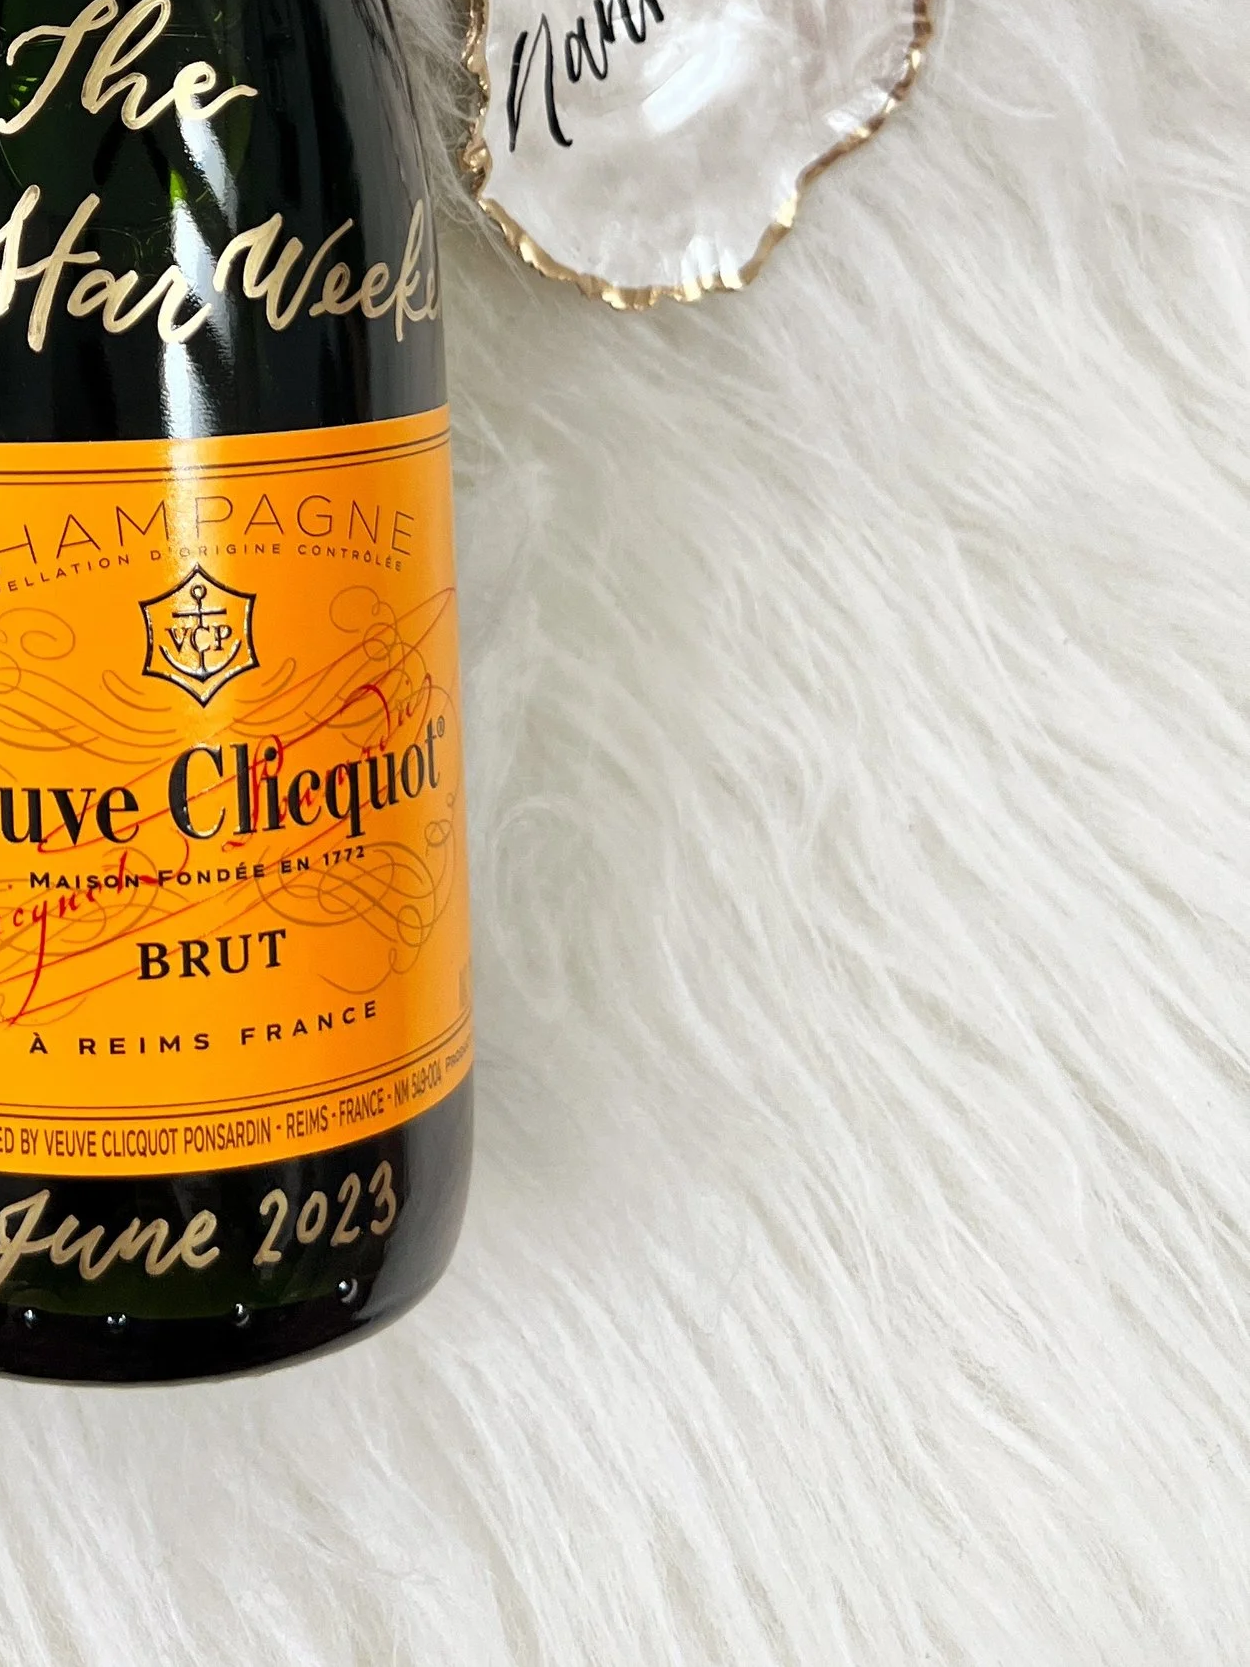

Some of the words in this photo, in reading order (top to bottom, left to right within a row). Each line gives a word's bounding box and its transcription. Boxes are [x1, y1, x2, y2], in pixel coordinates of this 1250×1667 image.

[150, 542, 282, 562] D'ORIGINE
[297, 543, 402, 573] CONTRÔLÉE
[165, 623, 233, 653] VCP
[280, 856, 312, 875] EN
[322, 844, 366, 868] 1772
[135, 927, 288, 982] BRUT
[29, 1031, 50, 1056] À
[77, 1032, 211, 1056] REIMS
[239, 999, 378, 1046] FRANCE
[20, 1127, 40, 1156] BY
[43, 1128, 98, 1158] VEUVE
[101, 1127, 179, 1158] CLICQUOT
[183, 1115, 271, 1155] PONSARDIN
[285, 1104, 329, 1140] REIMS
[338, 1086, 385, 1128] FRANCE
[393, 1074, 410, 1109] NM
[252, 1158, 399, 1268] 2023
